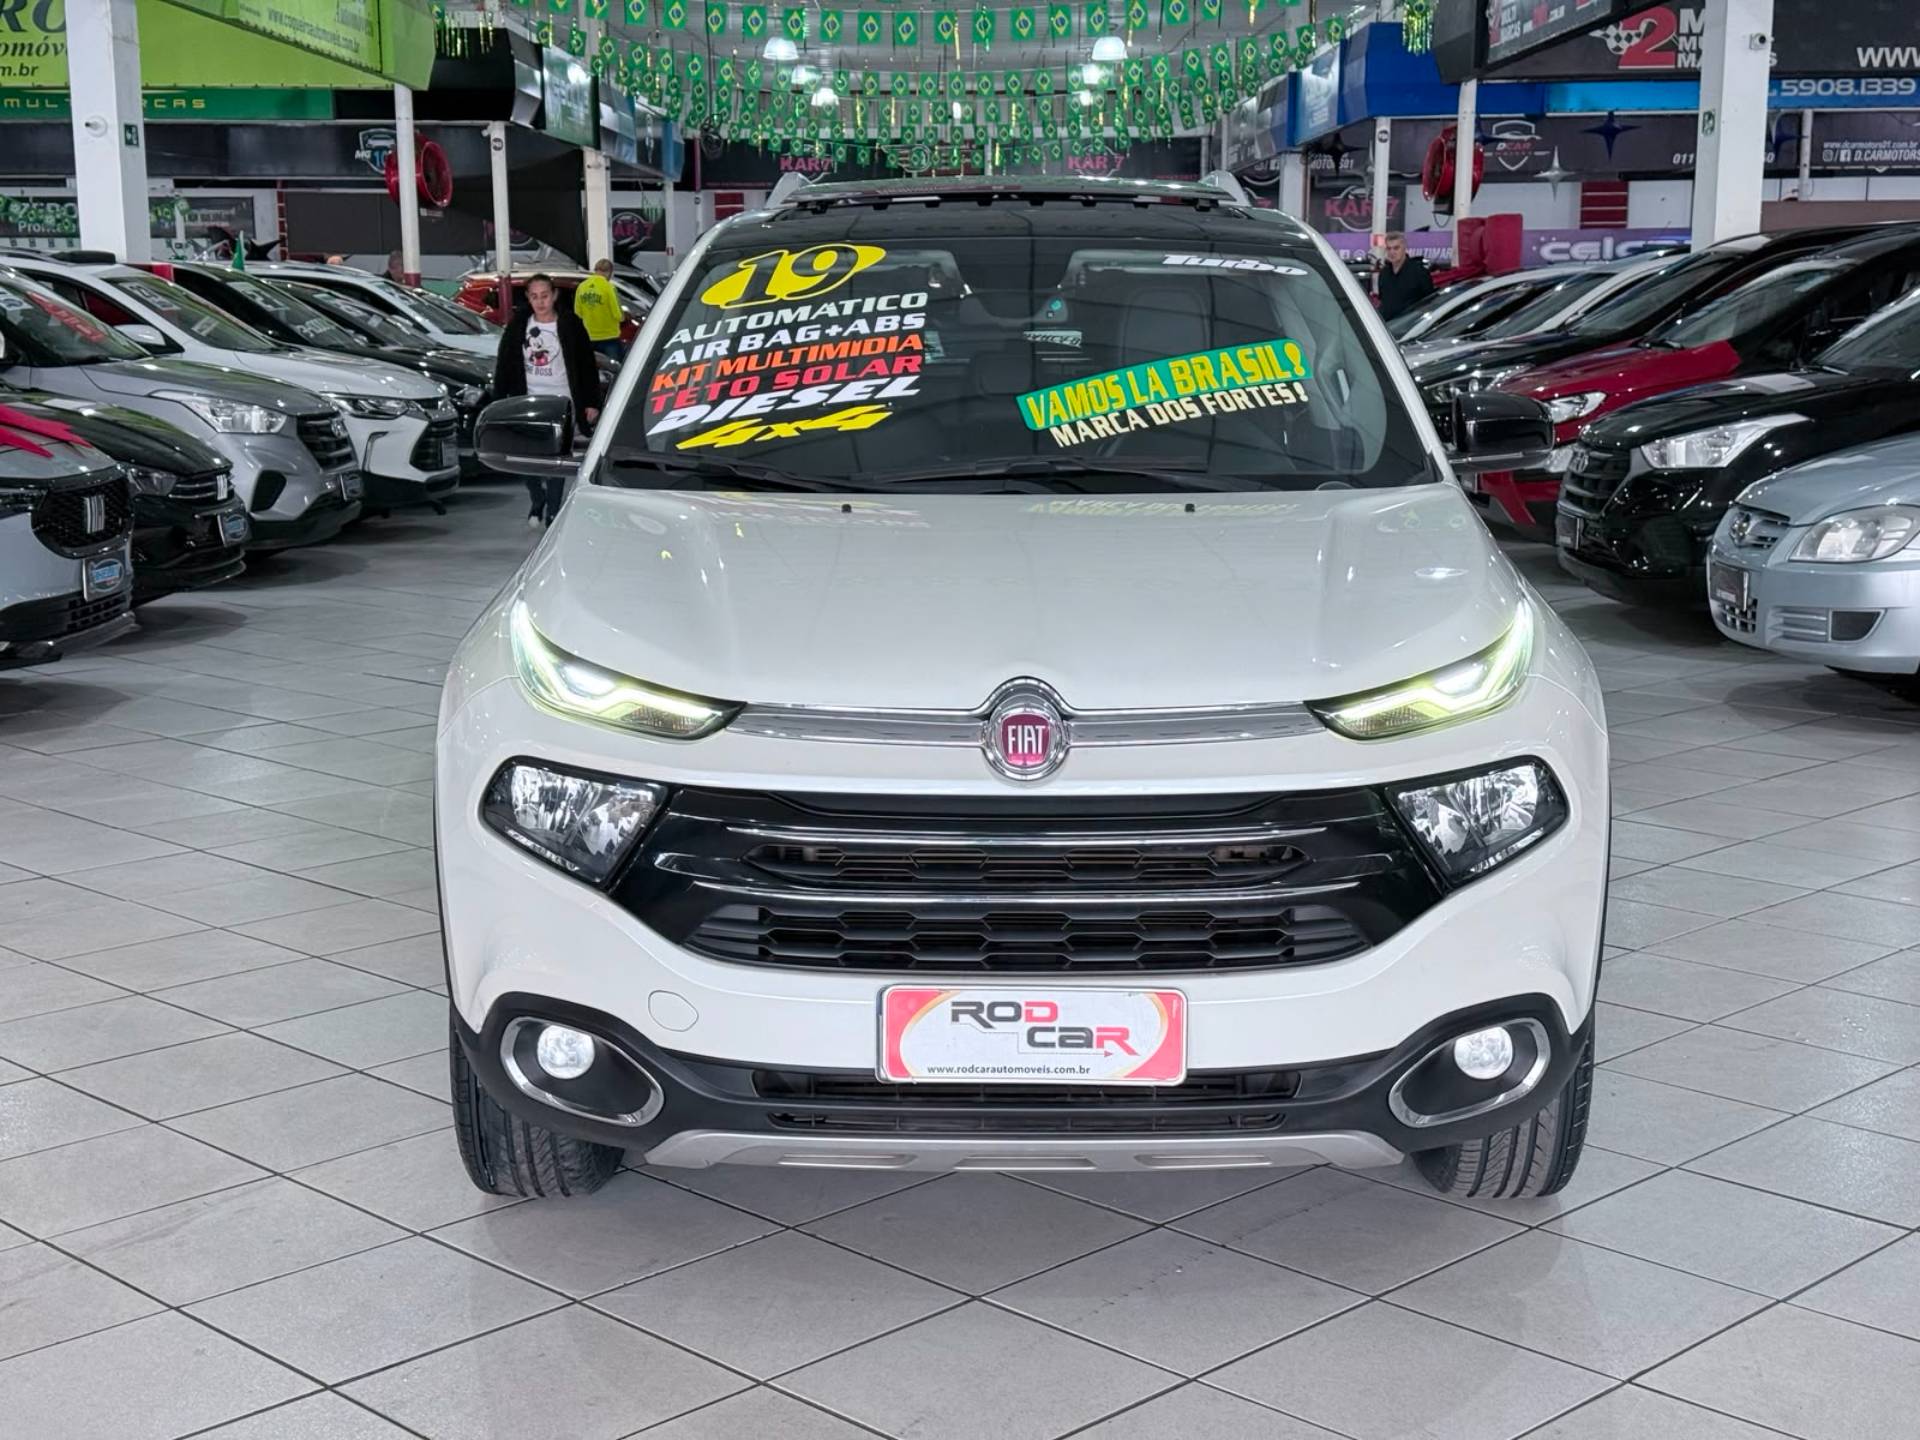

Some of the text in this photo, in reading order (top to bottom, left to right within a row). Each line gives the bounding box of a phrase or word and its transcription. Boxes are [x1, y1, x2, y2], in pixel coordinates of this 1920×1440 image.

[0, 35, 67, 57] omóv
[1780, 78, 1917, 97] 5908.1339
[1068, 156, 1107, 170] KAR
[719, 243, 860, 310] 19
[1162, 254, 1308, 275] Turbo
[660, 312, 927, 370] AIR BAG+ABS
[651, 364, 712, 393] KIT
[651, 355, 923, 414] TETO SOLAR
[1026, 342, 1306, 428] VAMOS LA BRASIL!
[646, 375, 921, 437] DIESEL
[1049, 381, 1309, 448] MARCA DOS FORTES!
[1007, 724, 1046, 755] FIAT
[926, 1064, 1091, 1077] www.rodcarautomoveis.com.br
